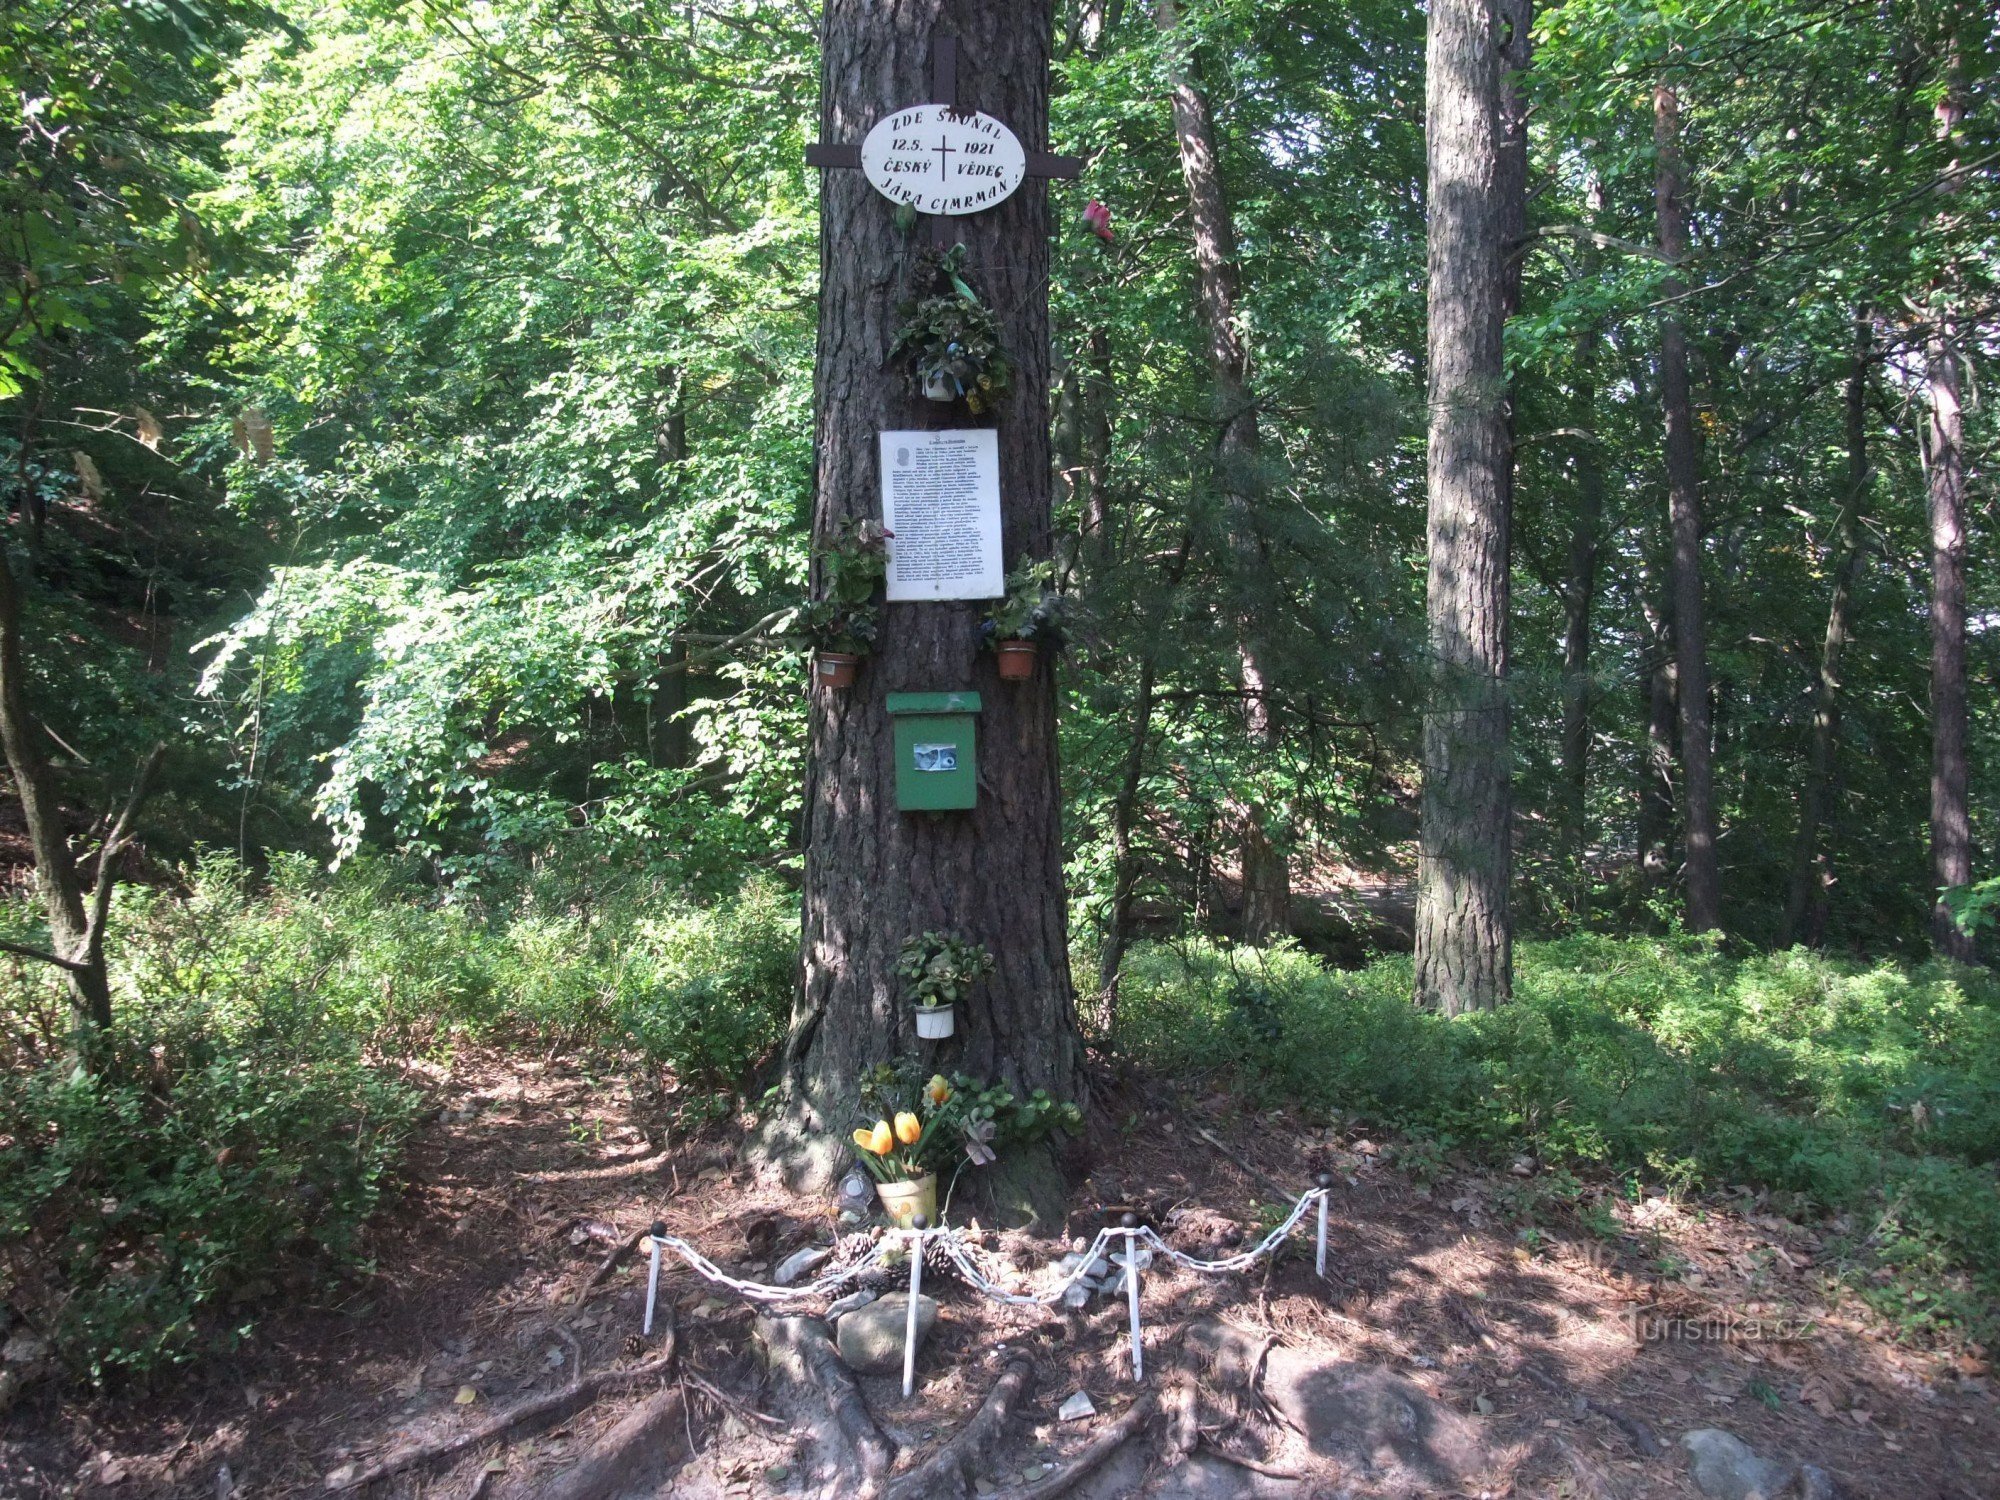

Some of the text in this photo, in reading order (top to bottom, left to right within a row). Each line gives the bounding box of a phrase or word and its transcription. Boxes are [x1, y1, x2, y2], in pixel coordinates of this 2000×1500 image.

[891, 112, 923, 132] ZDE
[891, 139, 994, 155] 12.5. 1921
[883, 157, 1004, 178] ČESKÝ VĚDEC
[880, 177, 922, 206] JÁRA
